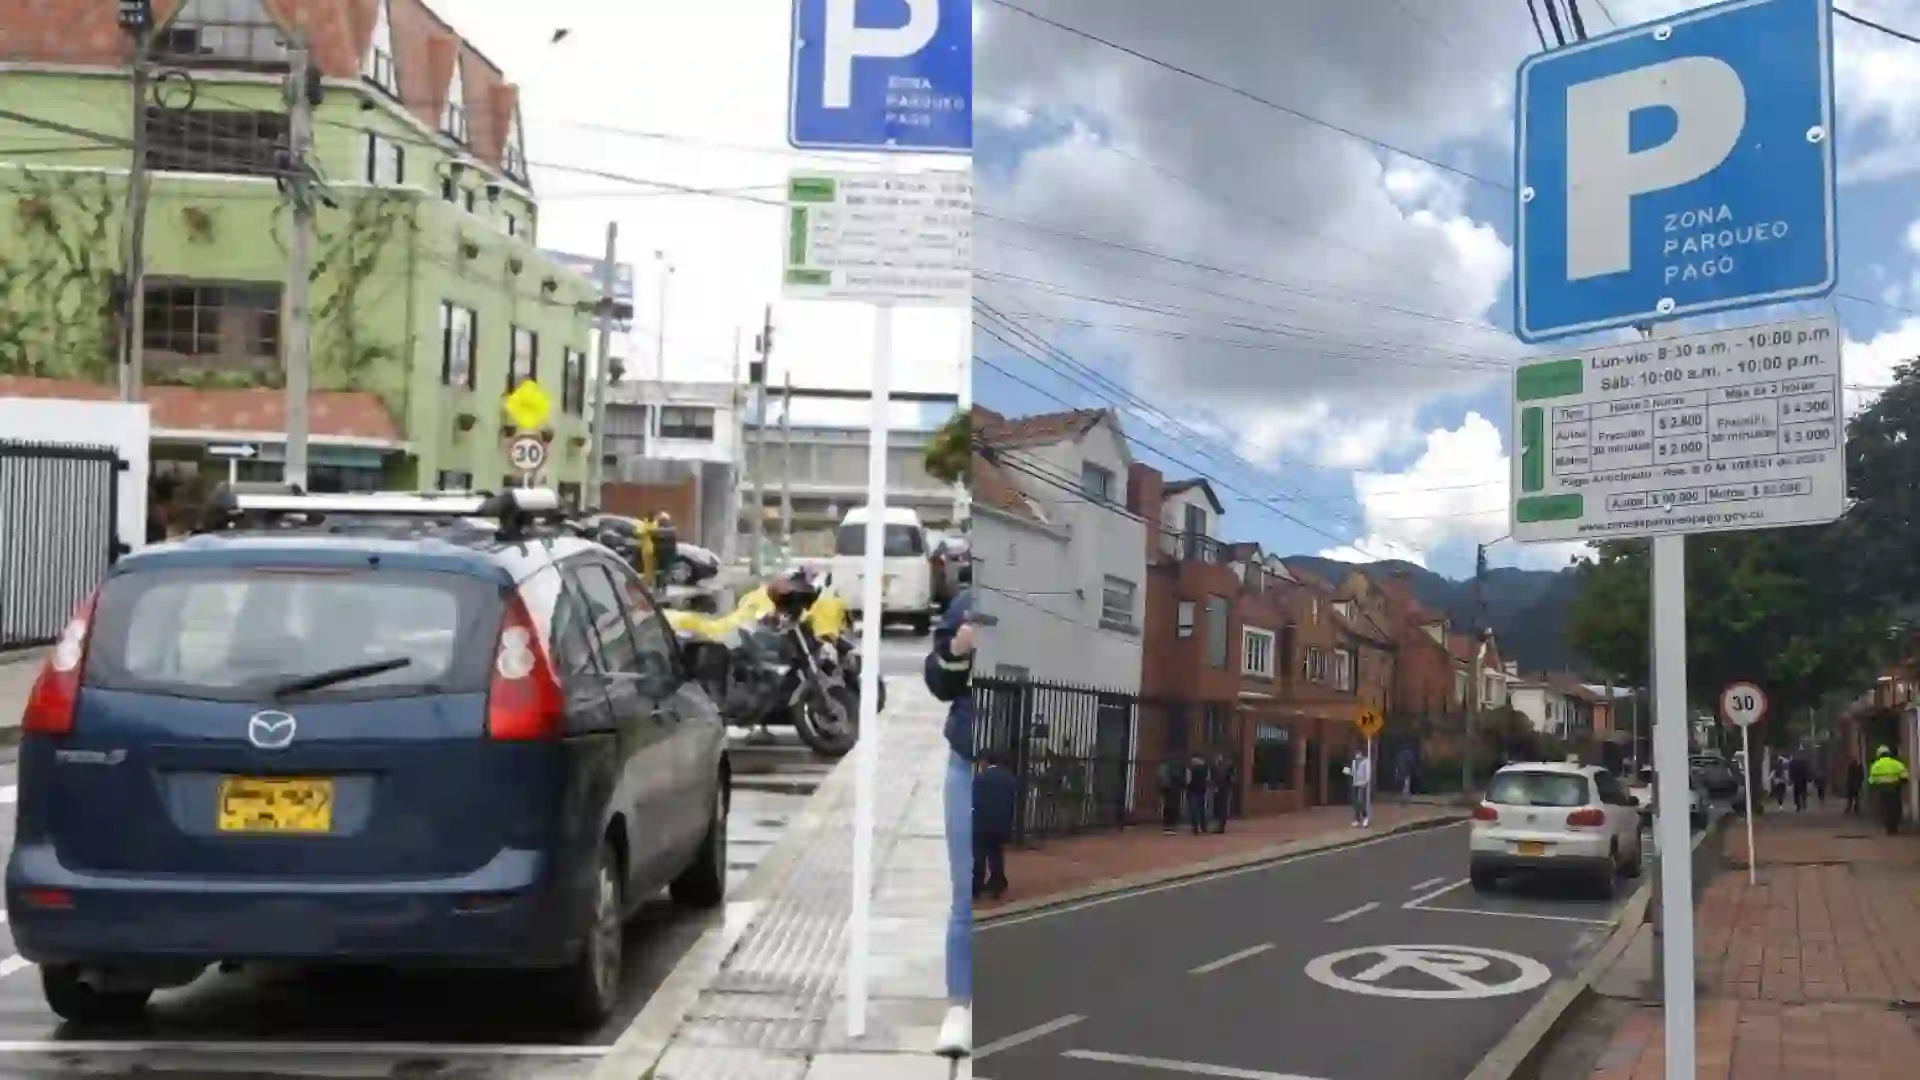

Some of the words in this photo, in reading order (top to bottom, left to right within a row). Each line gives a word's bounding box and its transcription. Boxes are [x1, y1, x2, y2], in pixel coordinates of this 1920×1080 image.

[822, 0, 940, 108] P
[1566, 55, 1746, 281] P
[1664, 204, 1733, 232] ZONA
[1664, 221, 1788, 257] PARQUEO
[1664, 257, 1734, 284] PAGO
[1749, 333, 1792, 350] 10:00
[1640, 368, 1683, 386] 10:00
[1738, 357, 1781, 373] 10:00
[515, 444, 541, 463] 30
[1731, 694, 1754, 711] 30
